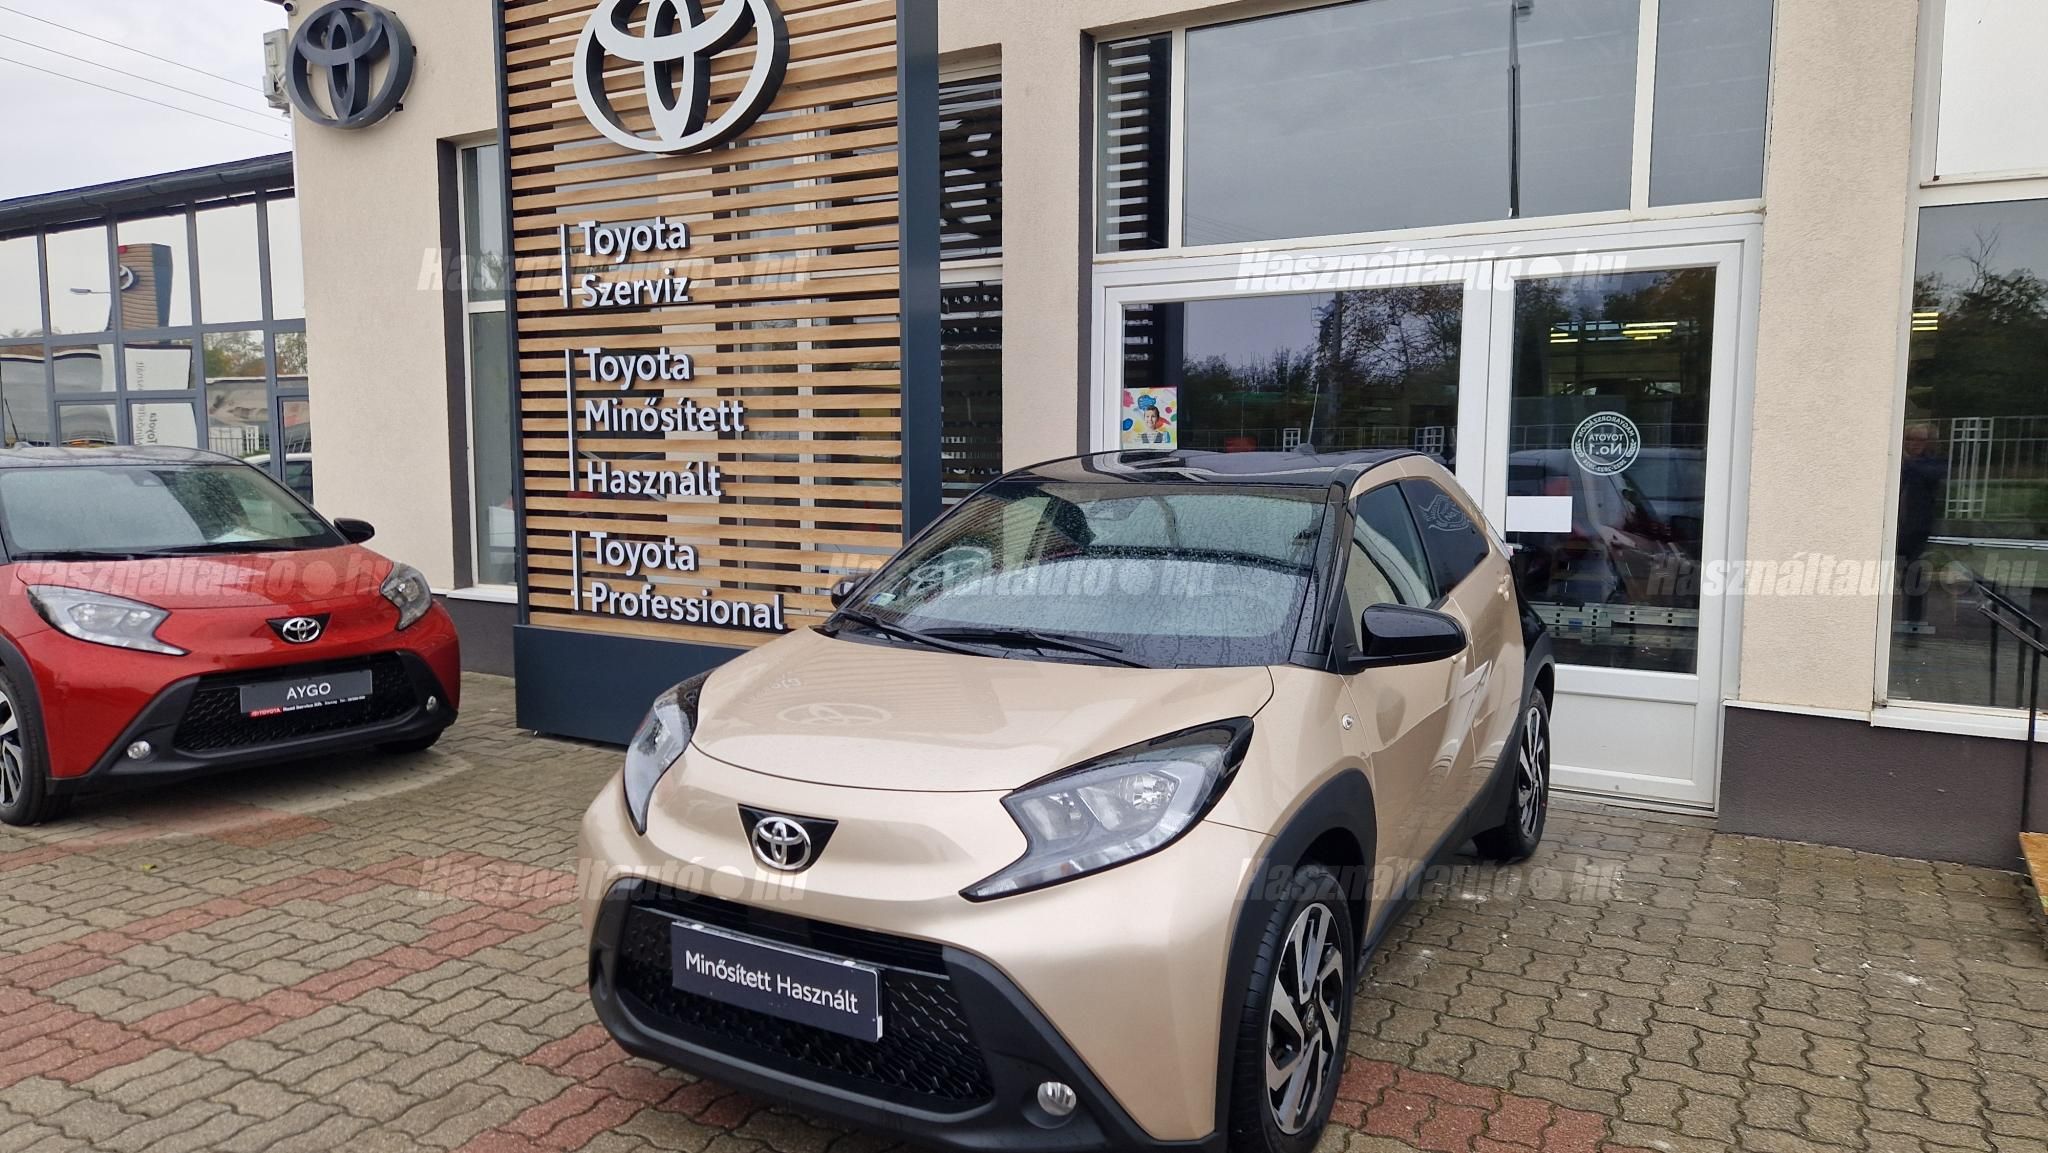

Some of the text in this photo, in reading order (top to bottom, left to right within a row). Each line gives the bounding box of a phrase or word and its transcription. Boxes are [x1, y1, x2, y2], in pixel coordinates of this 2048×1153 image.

[579, 216, 688, 263] Toyota
[582, 267, 690, 307] Szerviz
[583, 346, 692, 391] Toyota
[585, 396, 747, 432] Minősített
[588, 461, 724, 497] Használt
[590, 531, 697, 576] Toyota
[591, 582, 785, 630] Professional
[287, 683, 331, 700] AYGO
[685, 949, 859, 1014] Minősített Használt
